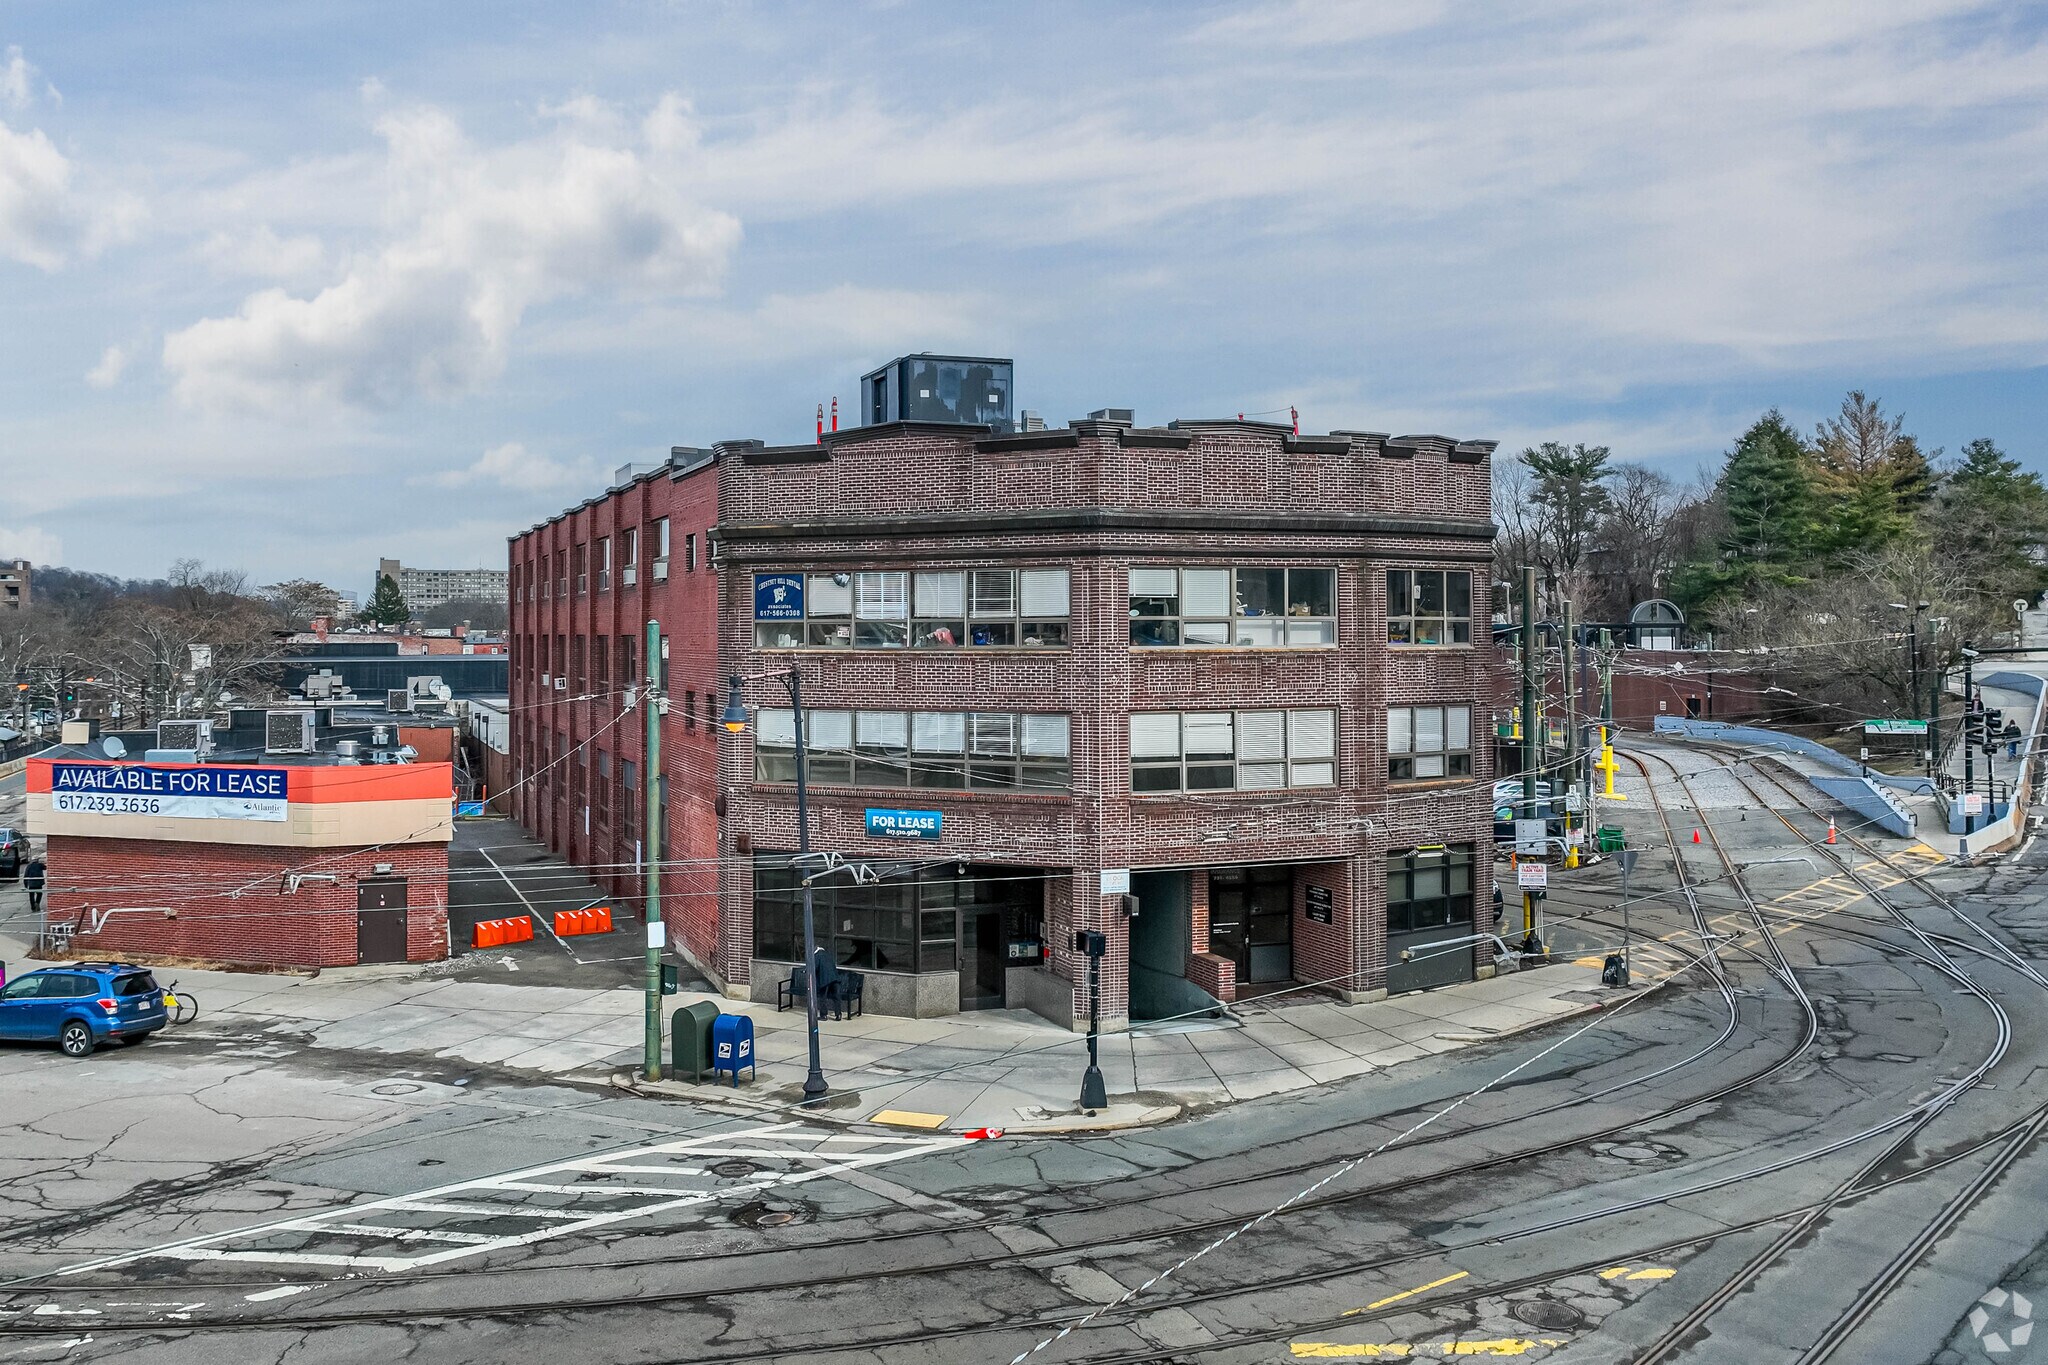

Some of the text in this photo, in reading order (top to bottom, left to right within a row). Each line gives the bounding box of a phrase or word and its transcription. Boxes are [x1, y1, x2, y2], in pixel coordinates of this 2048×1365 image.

[758, 578, 777, 590] CHESTNUT
[786, 578, 801, 590] DENTAL
[59, 769, 281, 794] AVAILABLE FOR LEASE
[59, 794, 160, 813] 617.239.3636
[252, 803, 281, 812] Atlantic
[872, 815, 935, 829] FOR LEASE
